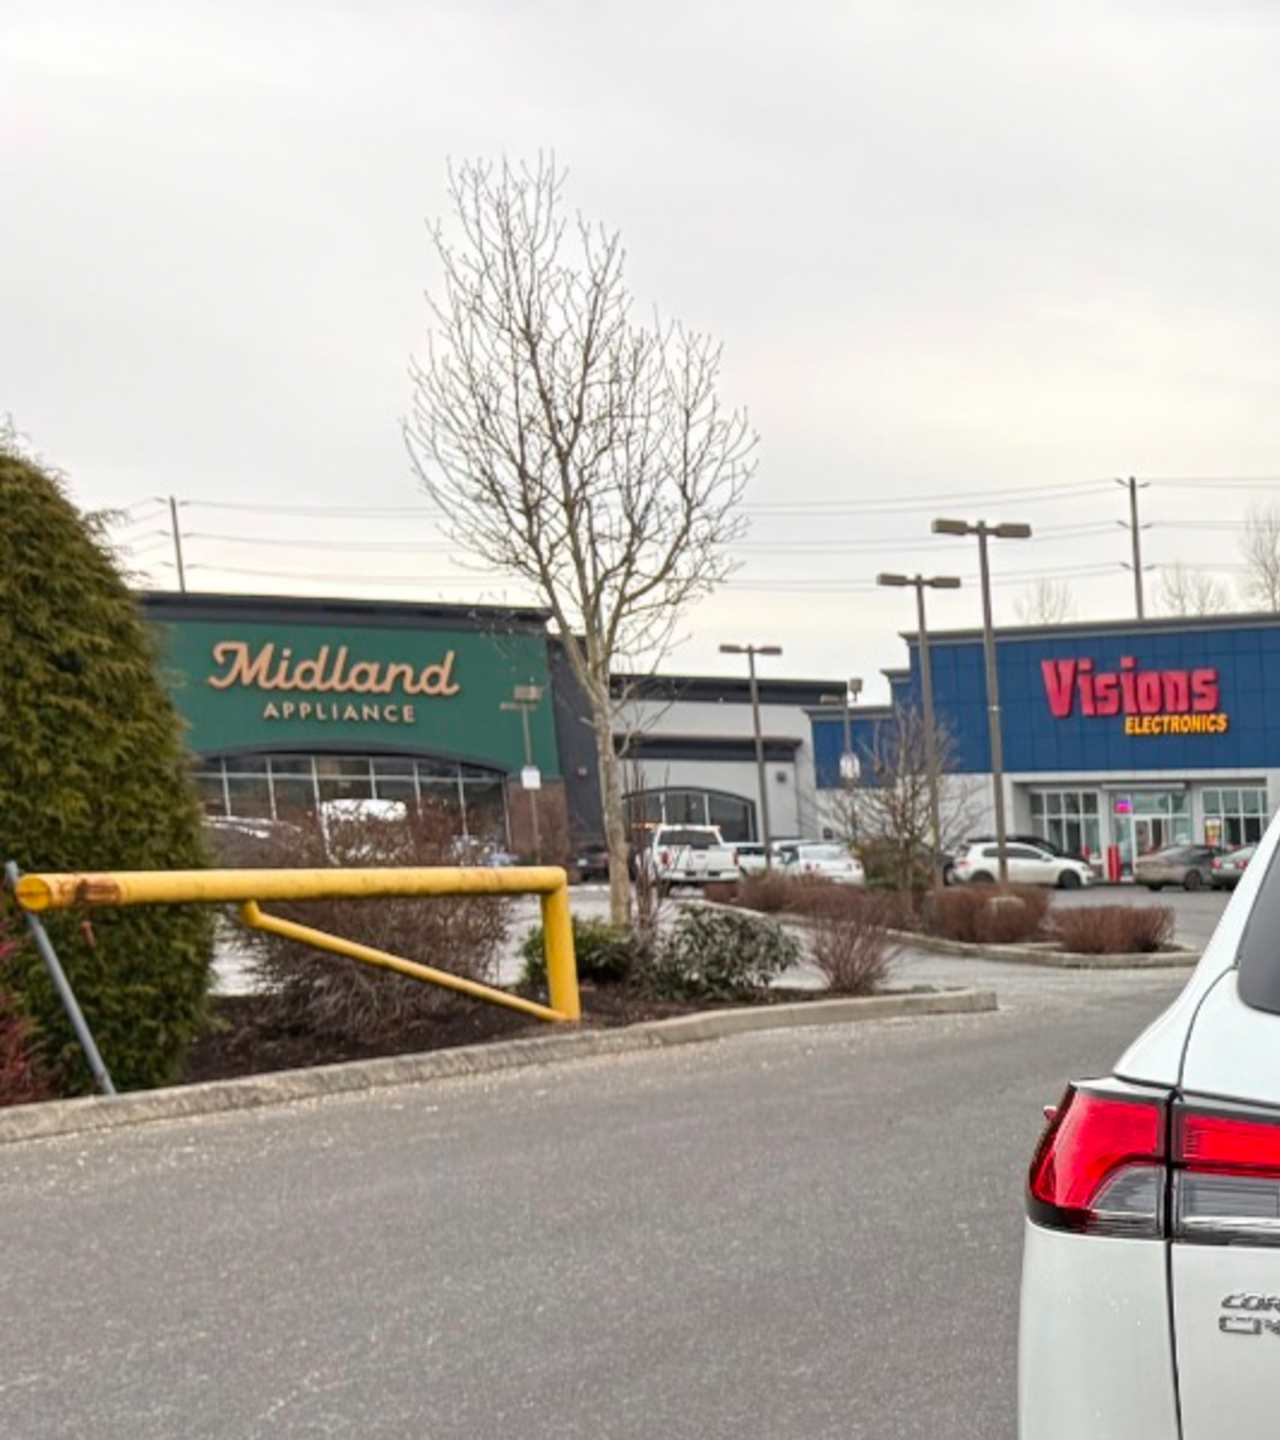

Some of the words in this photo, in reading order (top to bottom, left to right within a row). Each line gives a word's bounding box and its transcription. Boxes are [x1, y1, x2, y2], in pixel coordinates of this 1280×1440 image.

[208, 641, 460, 696] Midland
[1040, 656, 1220, 719] Visions
[263, 702, 417, 722] APPLIANCE
[1124, 714, 1228, 735] ELECTRONICS
